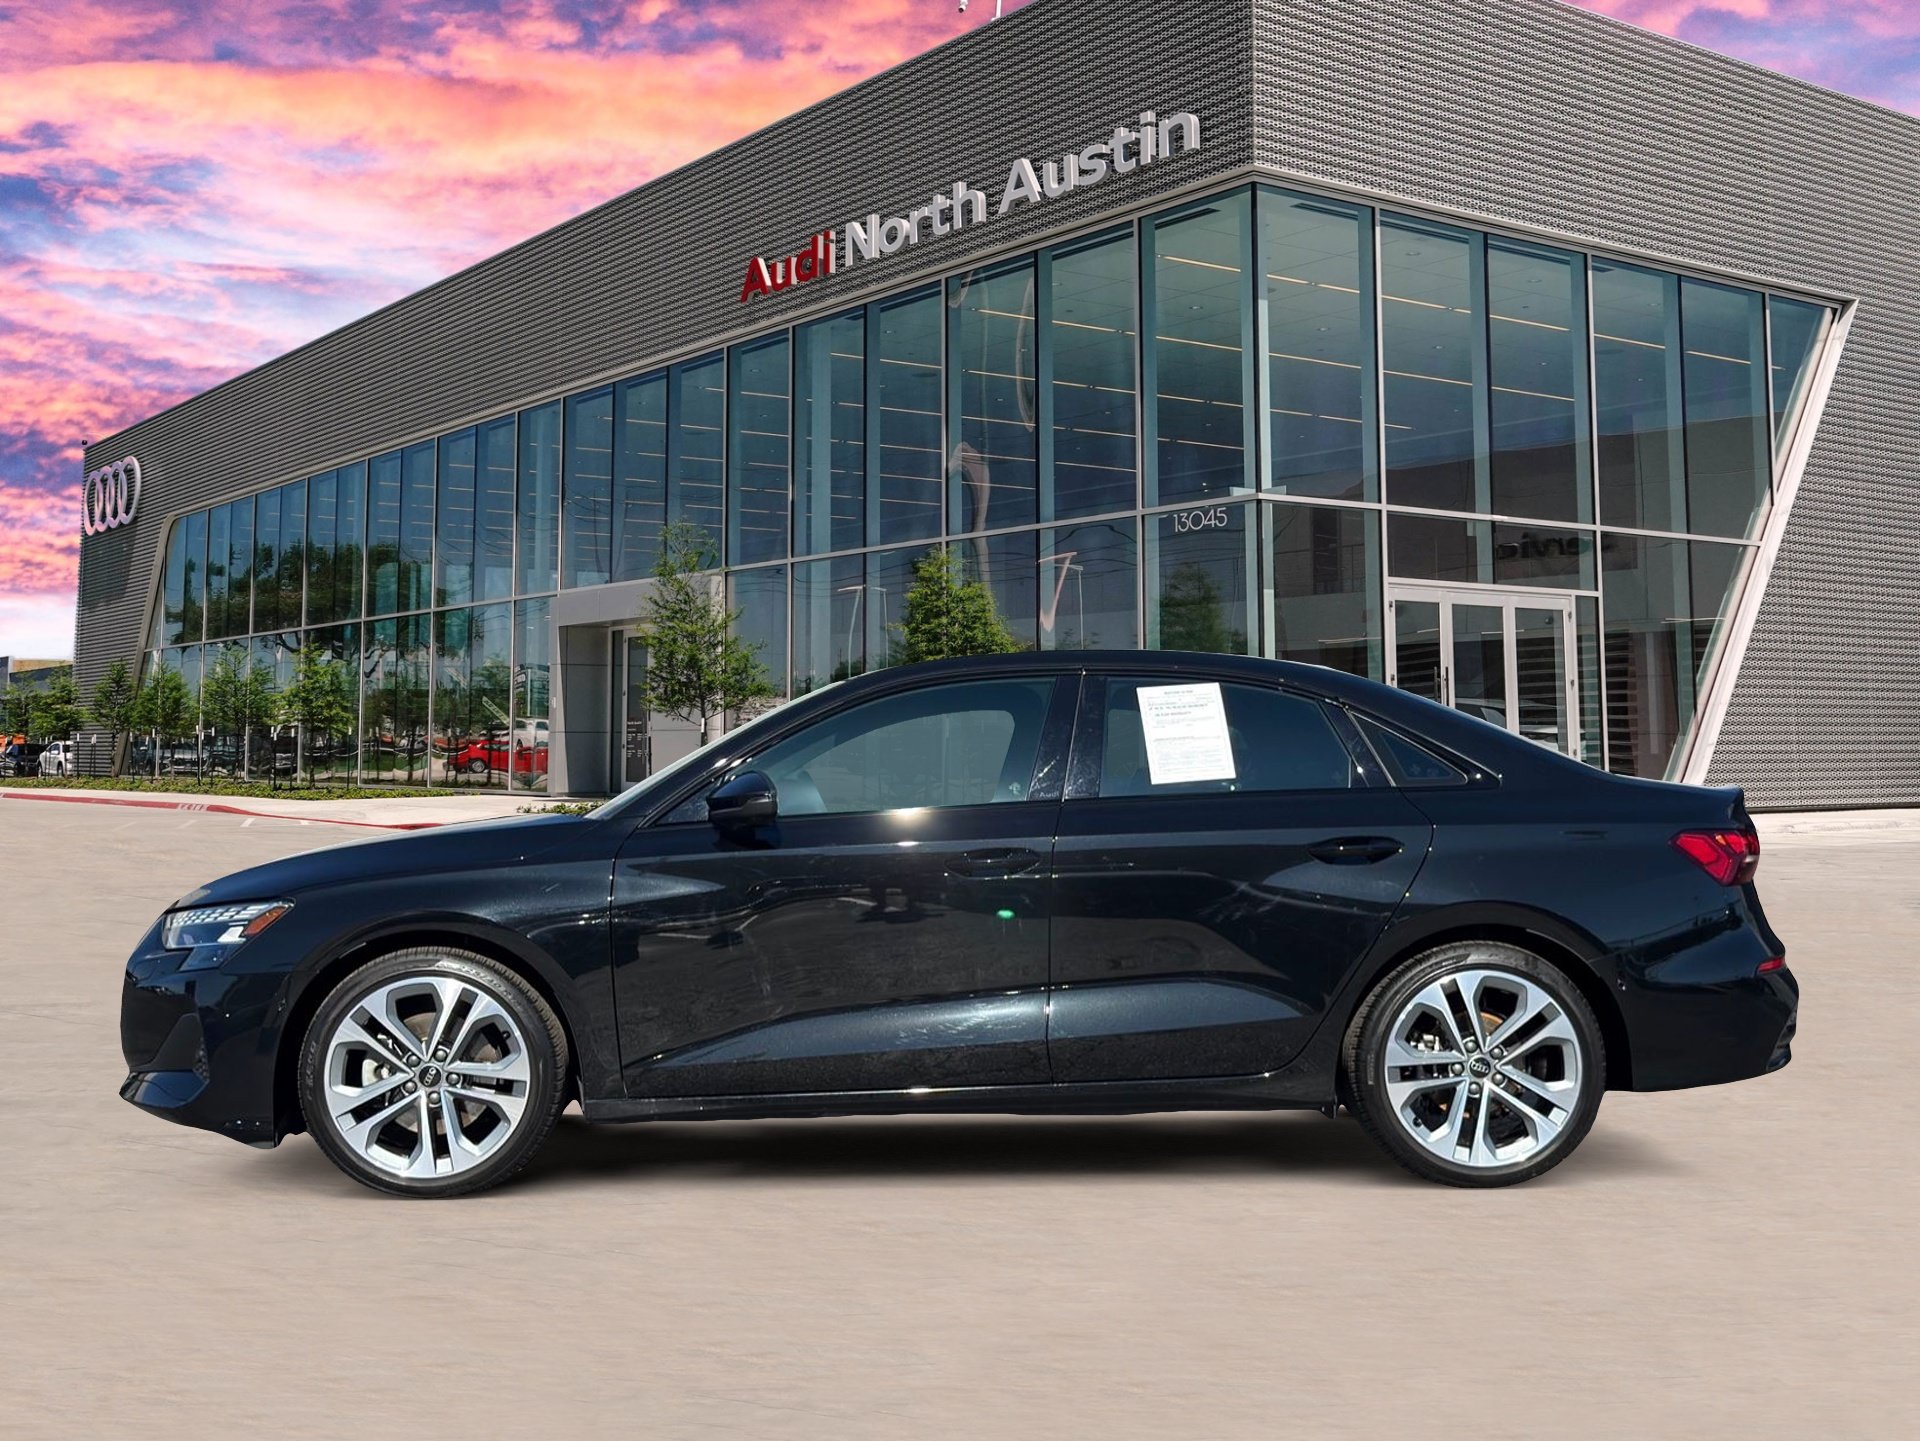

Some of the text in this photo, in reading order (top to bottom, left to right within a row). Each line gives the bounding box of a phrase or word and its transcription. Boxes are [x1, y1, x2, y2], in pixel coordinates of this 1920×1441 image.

[740, 110, 1201, 303] Audi North Austin
[1173, 507, 1228, 533] 13045
